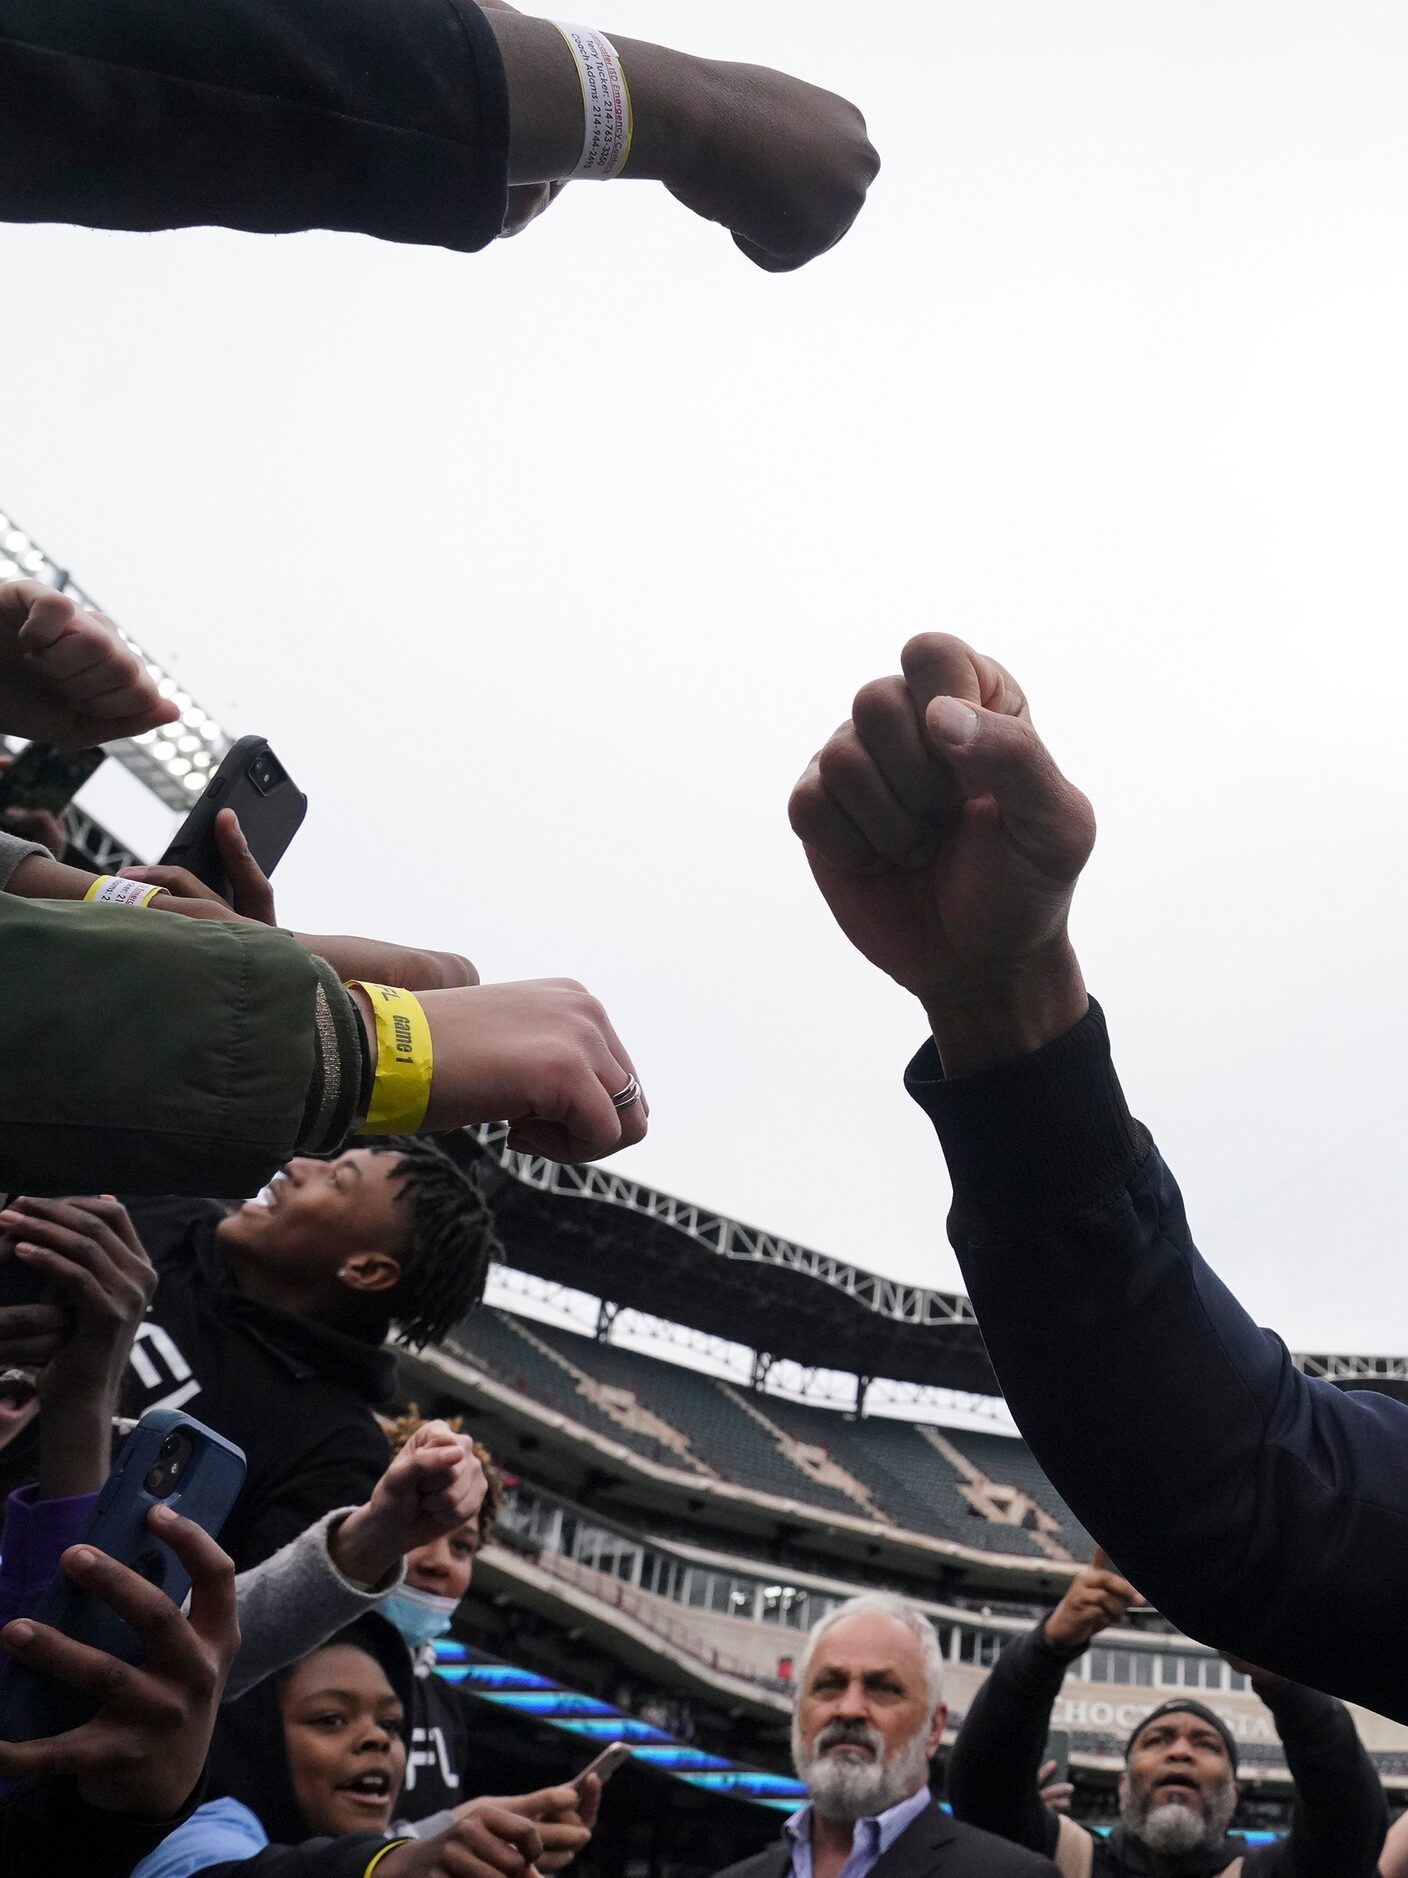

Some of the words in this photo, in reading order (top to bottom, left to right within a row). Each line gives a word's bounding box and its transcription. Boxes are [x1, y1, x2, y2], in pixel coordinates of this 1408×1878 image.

[573, 33, 590, 60] Coach
[585, 62, 599, 102] Adams:
[586, 39, 599, 60] Terry
[595, 61, 609, 99] Tucker:
[609, 67, 618, 81] ISD
[613, 84, 623, 140] Emergency
[393, 1015, 413, 1052] Game
